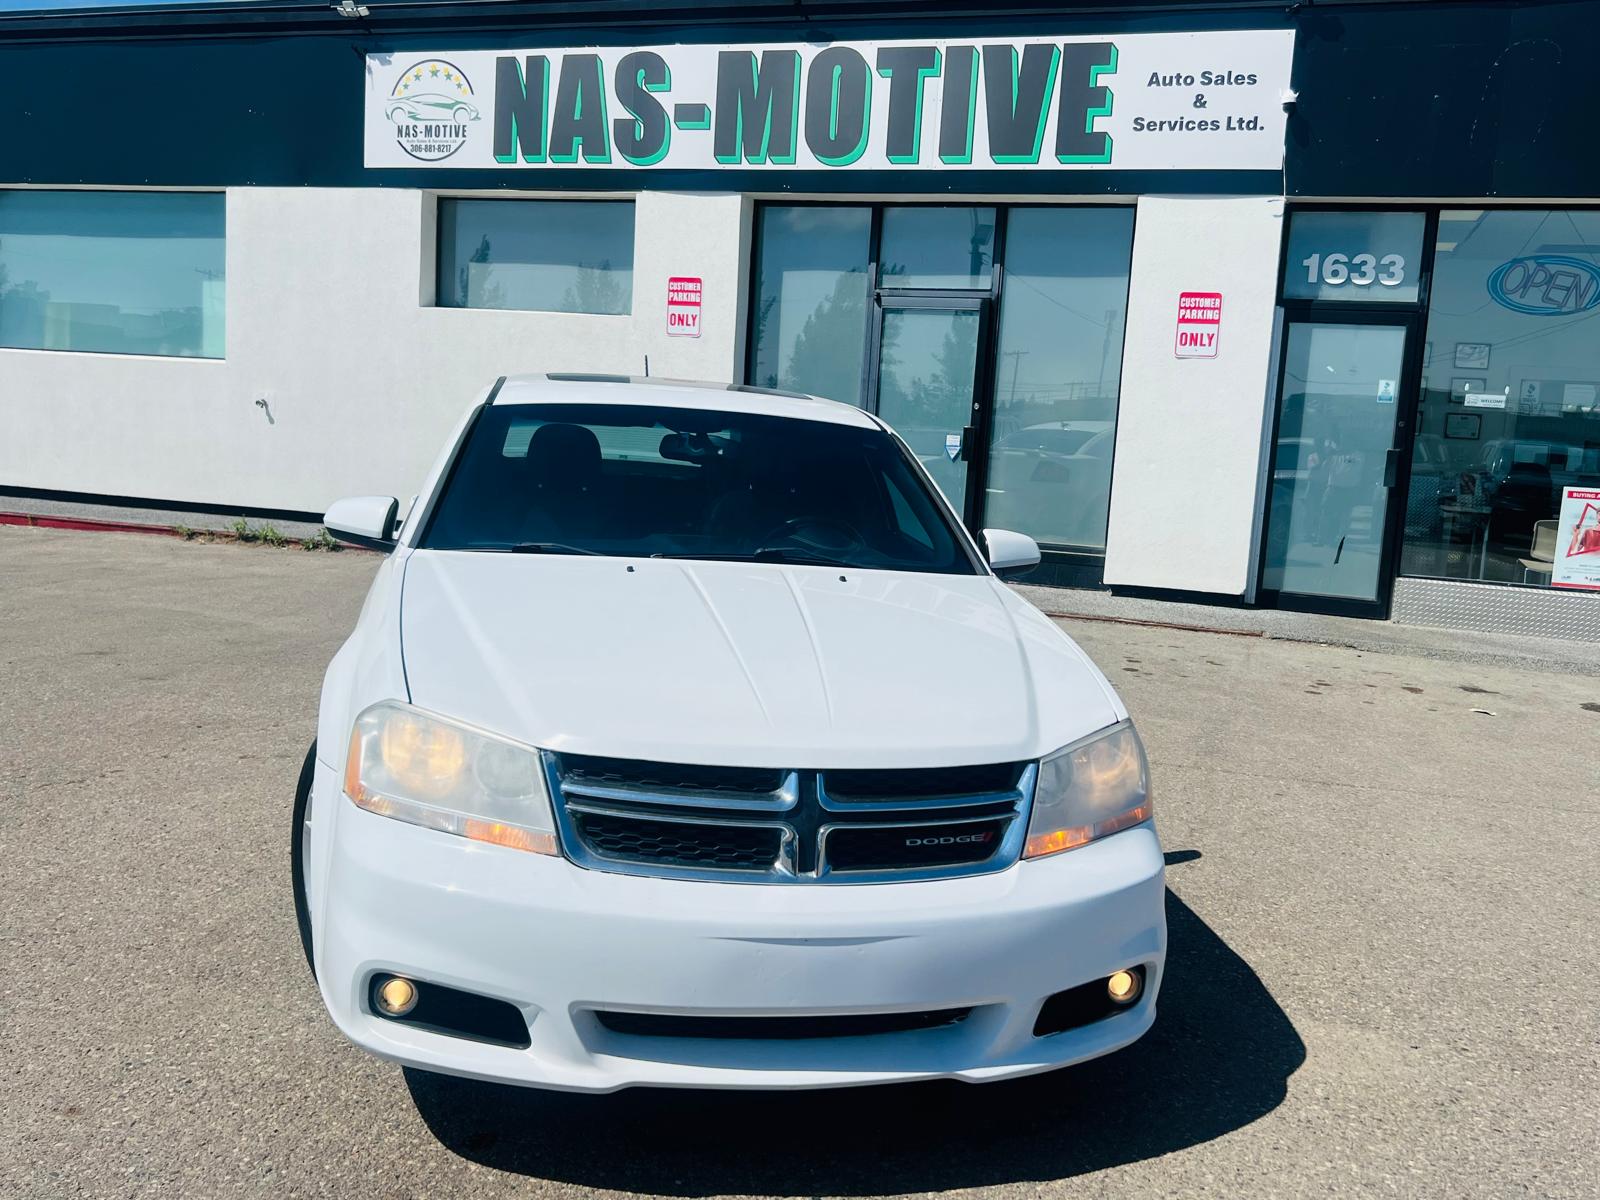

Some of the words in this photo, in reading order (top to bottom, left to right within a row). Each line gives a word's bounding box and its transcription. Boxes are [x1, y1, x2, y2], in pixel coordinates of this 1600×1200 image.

[1147, 72, 1195, 87] Auto
[1199, 70, 1258, 86] Sales
[493, 43, 1118, 167] NAS-MOTIVE
[1192, 93, 1207, 108] &
[397, 124, 467, 138] NAS-MOTIVE
[1132, 117, 1221, 132] Services
[1225, 116, 1265, 131] Ltd.
[1302, 253, 1405, 286] 1633
[670, 282, 701, 291] CUSTOMER
[1502, 262, 1593, 310] OPEN
[669, 292, 701, 302] PARKING
[1180, 297, 1221, 308] CUSTOMER
[670, 313, 698, 327] ONLY
[1179, 309, 1220, 320] PARKING
[1179, 332, 1216, 347] ONLY
[905, 833, 985, 846] DODGE
